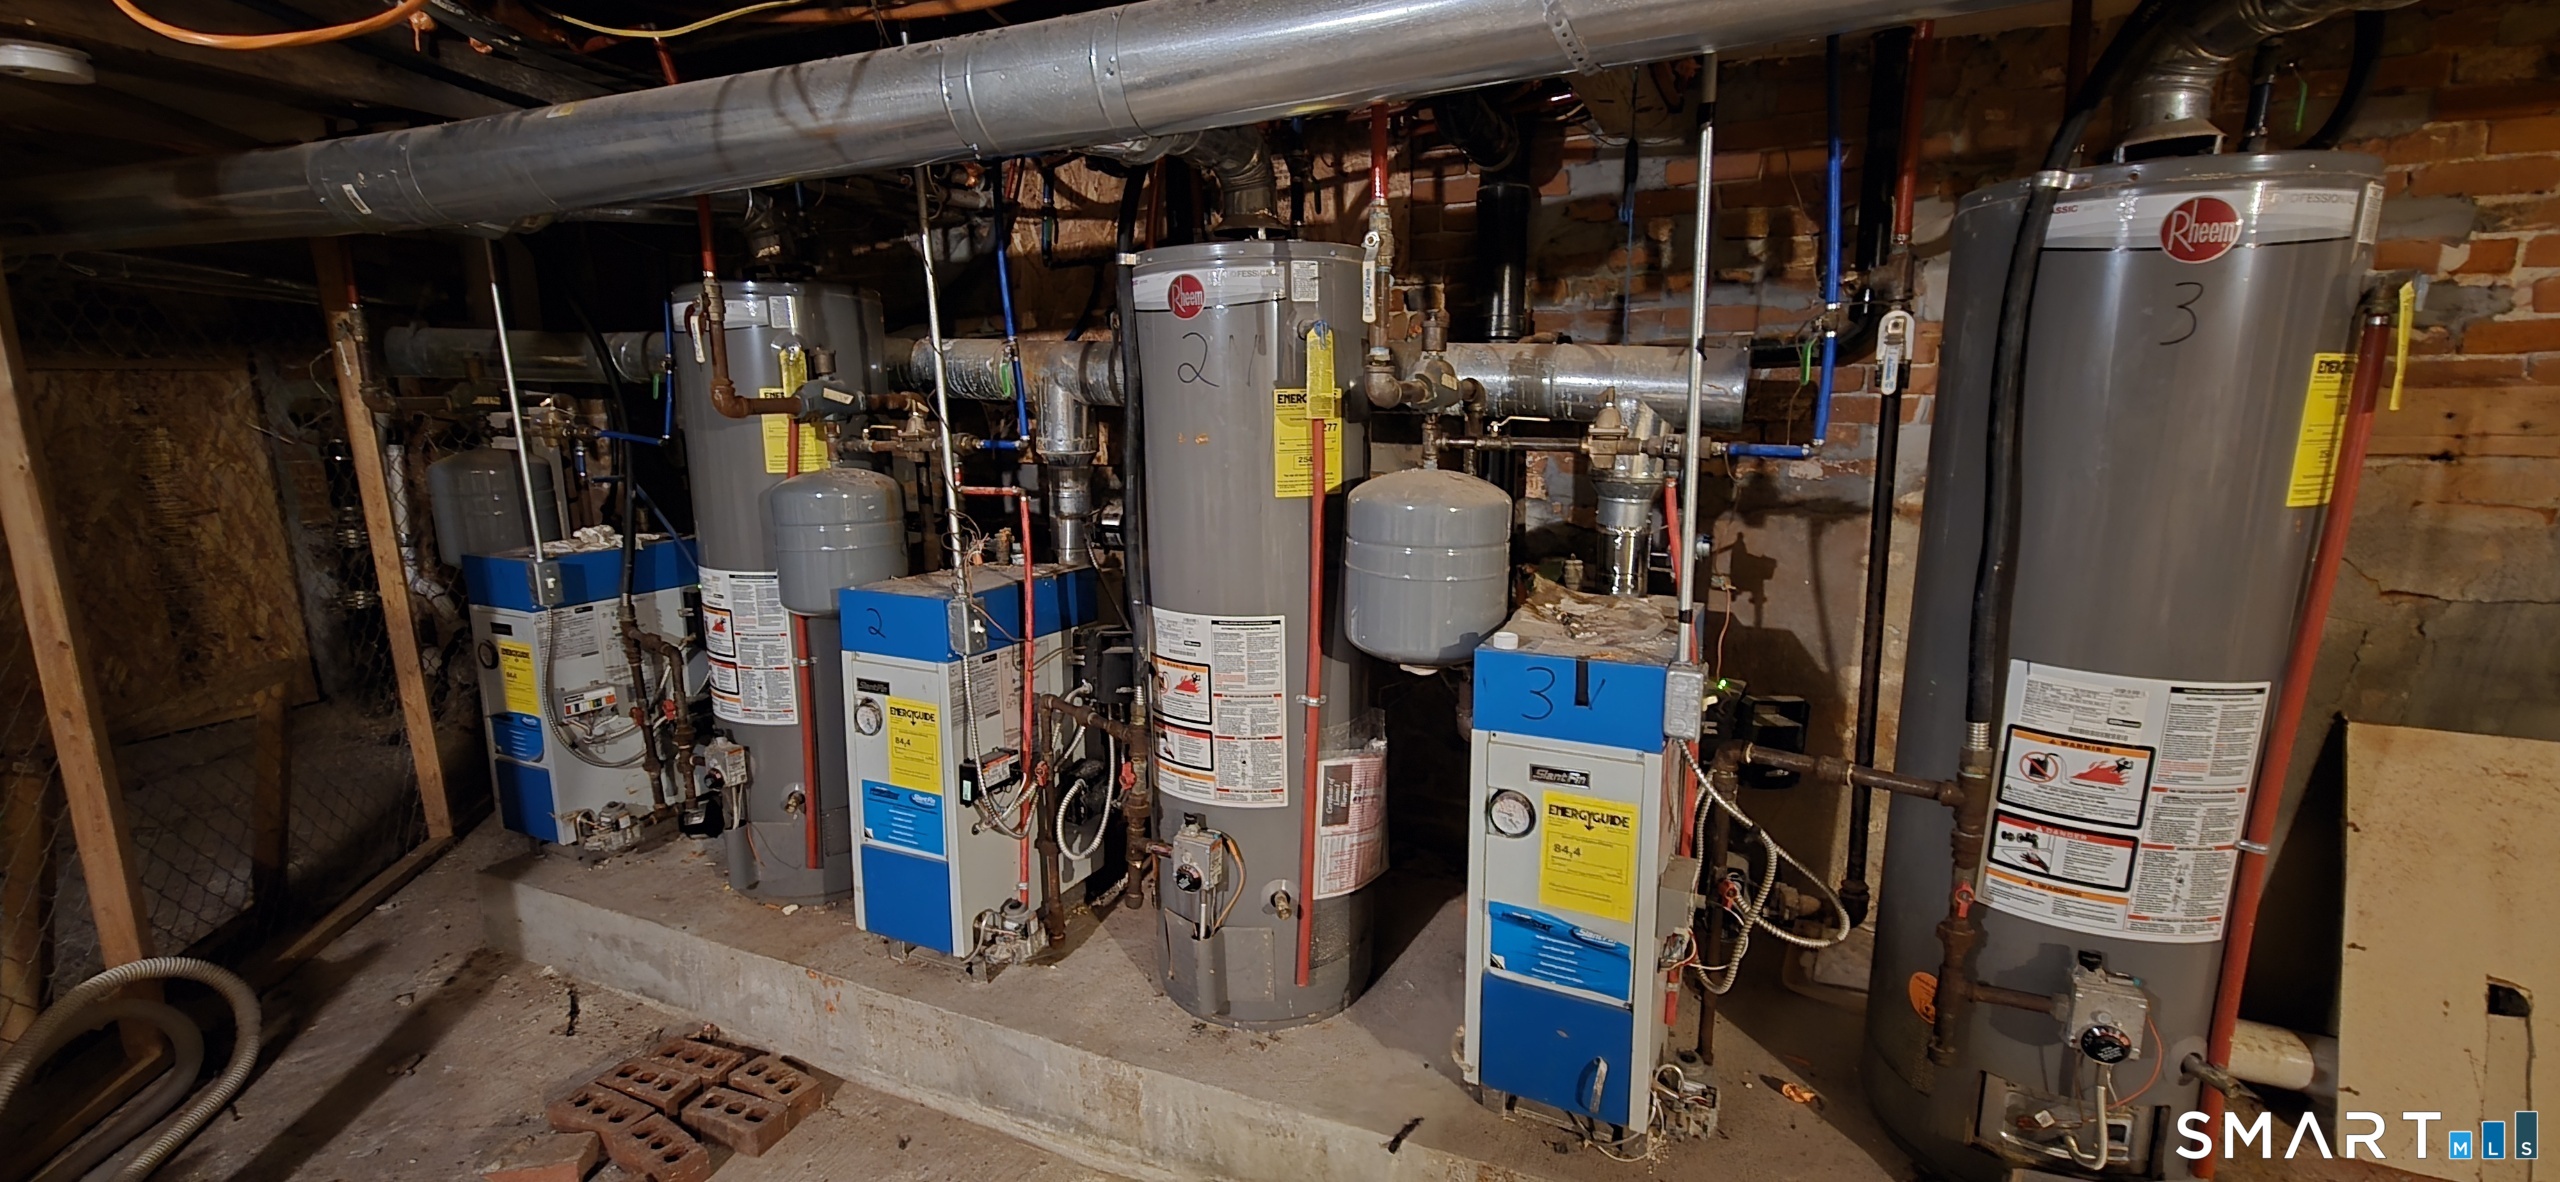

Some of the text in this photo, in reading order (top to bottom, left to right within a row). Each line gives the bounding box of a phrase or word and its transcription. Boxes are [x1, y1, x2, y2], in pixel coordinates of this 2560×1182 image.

[2168, 199, 2236, 252] Rheem
[1171, 276, 1204, 313] Rheem
[2159, 281, 2204, 346] 3
[1177, 332, 1220, 388] 2
[866, 607, 886, 639] 2
[1521, 666, 1556, 720] 3
[889, 706, 936, 723] ENERGYGUIDE
[2060, 741, 2111, 755] WARNING
[1548, 804, 1631, 829] ENERGYGUIDE
